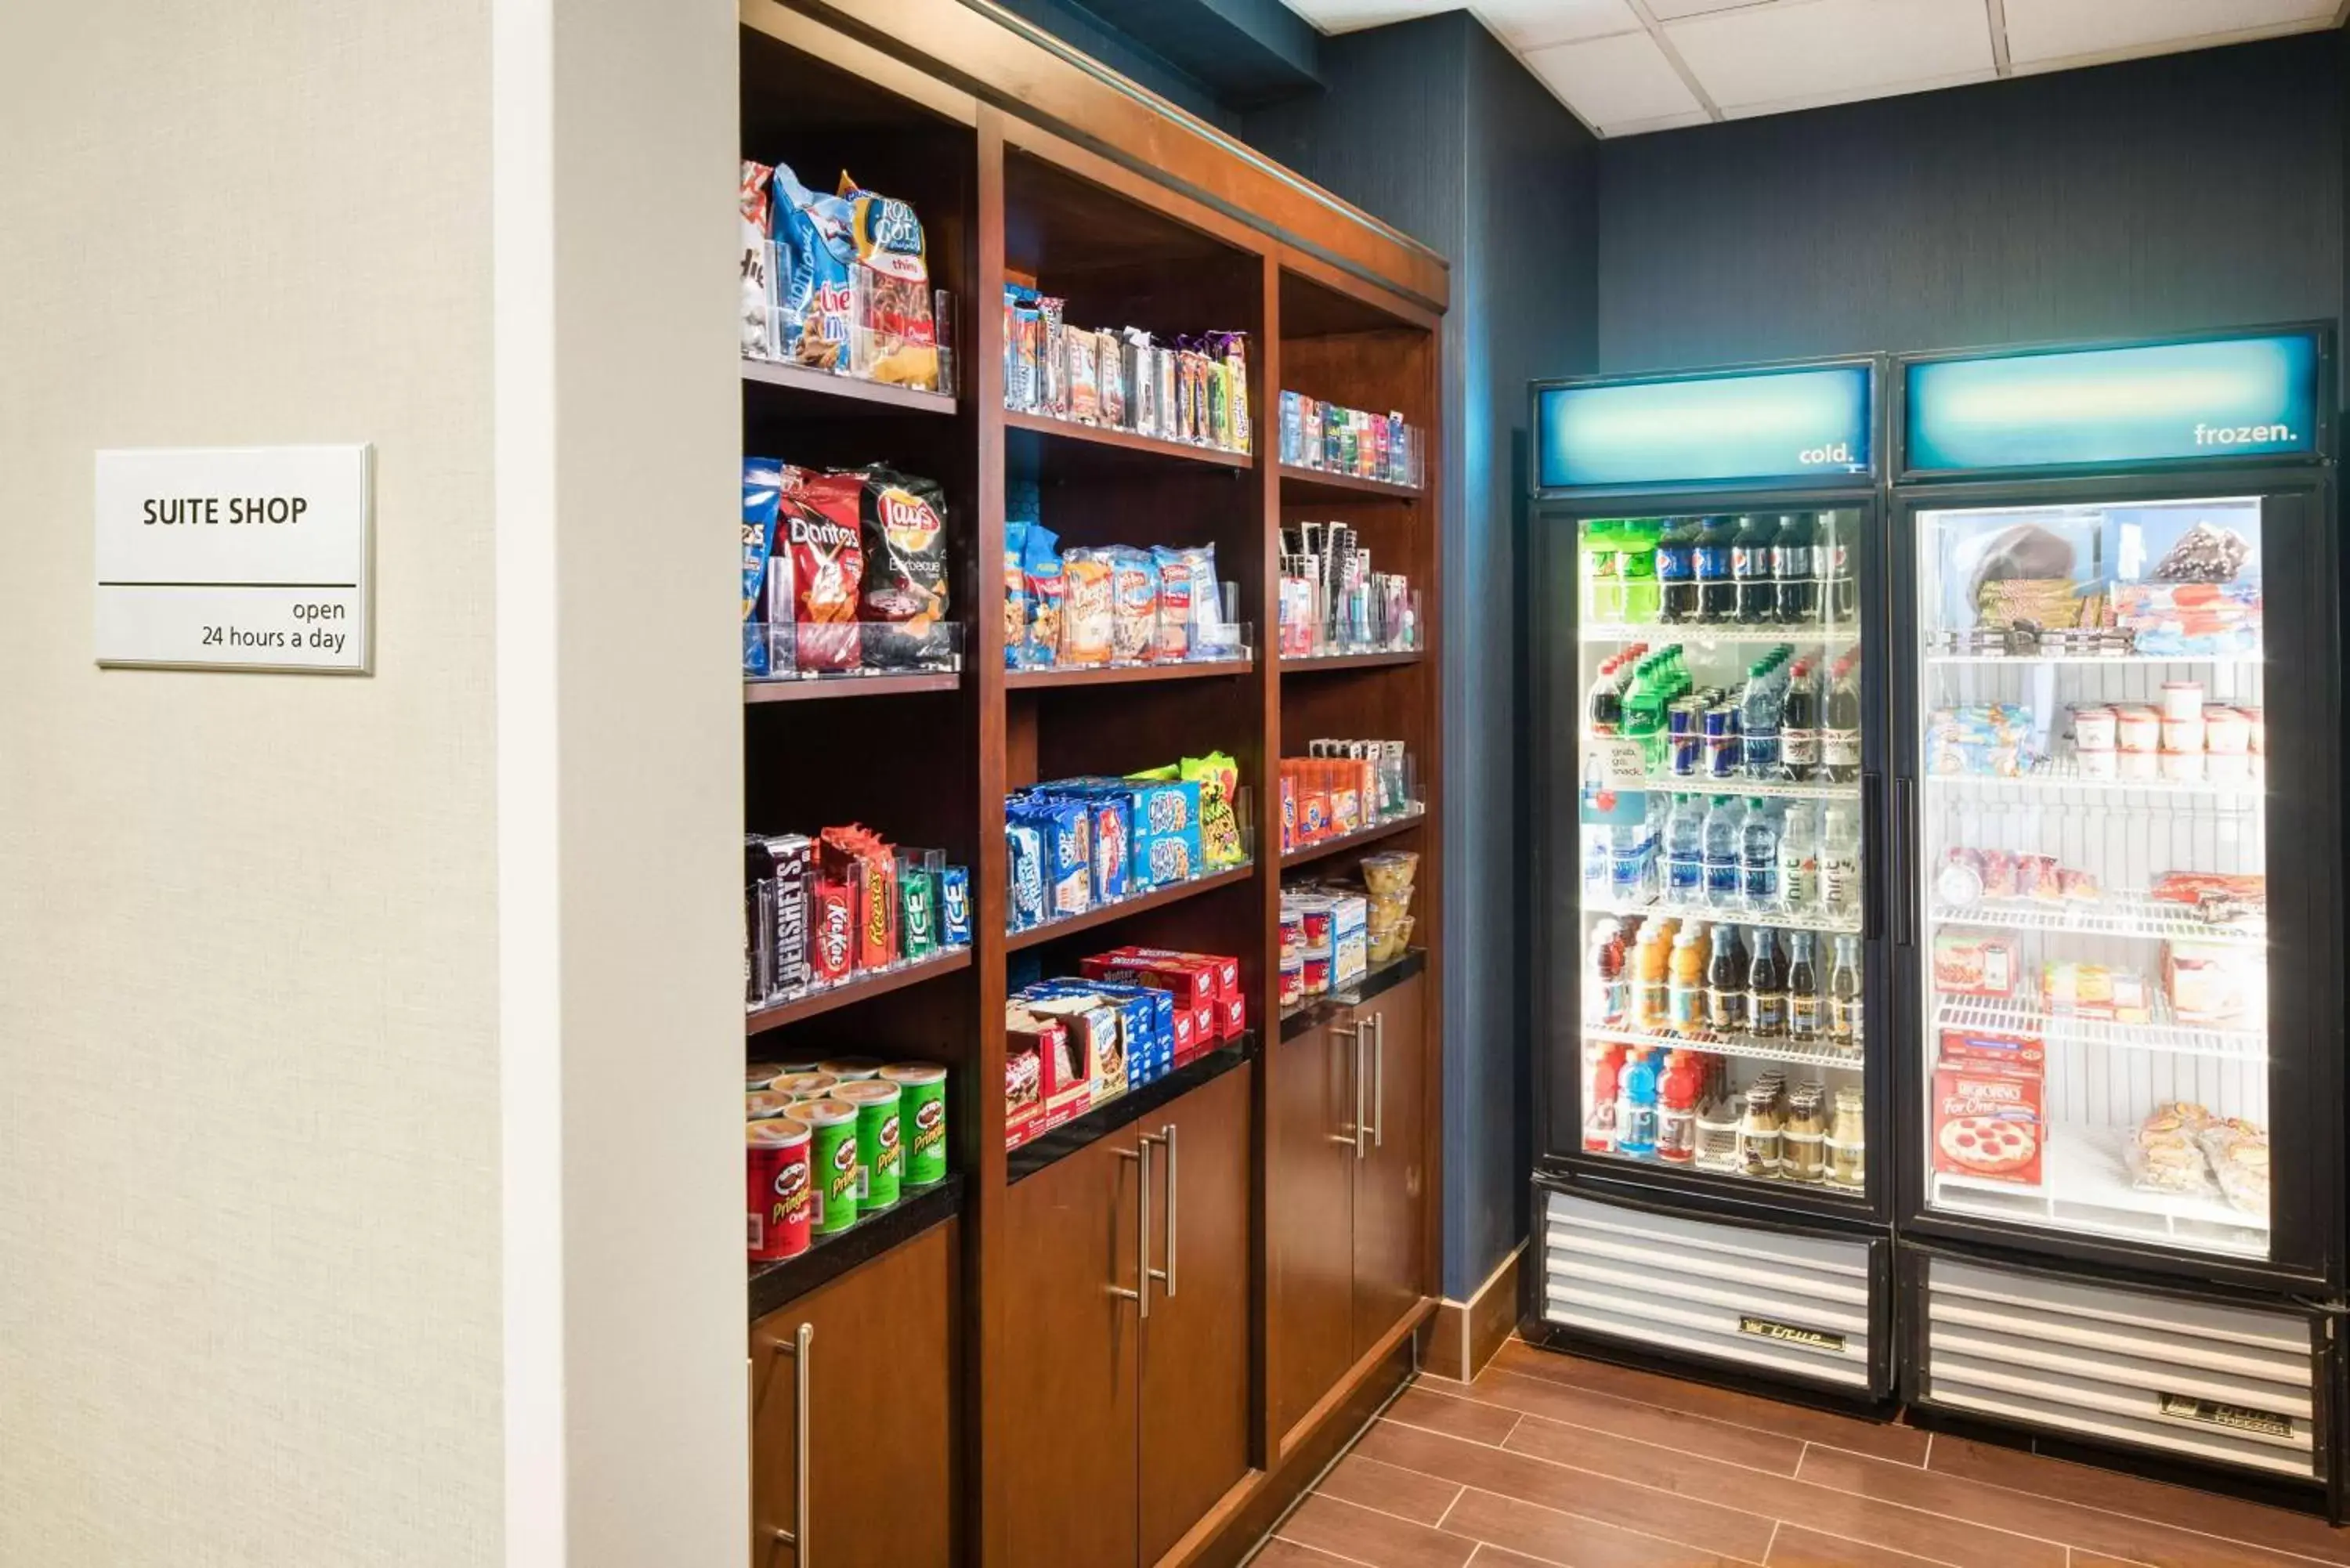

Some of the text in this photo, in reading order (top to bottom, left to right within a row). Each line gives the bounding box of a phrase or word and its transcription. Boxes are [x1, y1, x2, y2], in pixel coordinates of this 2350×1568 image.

[2194, 423, 2298, 446] frozen.
[1799, 443, 1854, 464] cold.
[143, 497, 308, 526] SUITE SHOP
[790, 518, 859, 547] Doritos
[293, 602, 345, 623] open
[201, 627, 345, 653] 24 hours a day
[776, 860, 802, 984] HERSHEY'S
[906, 892, 929, 945] ICE
[944, 883, 967, 934] ICE
